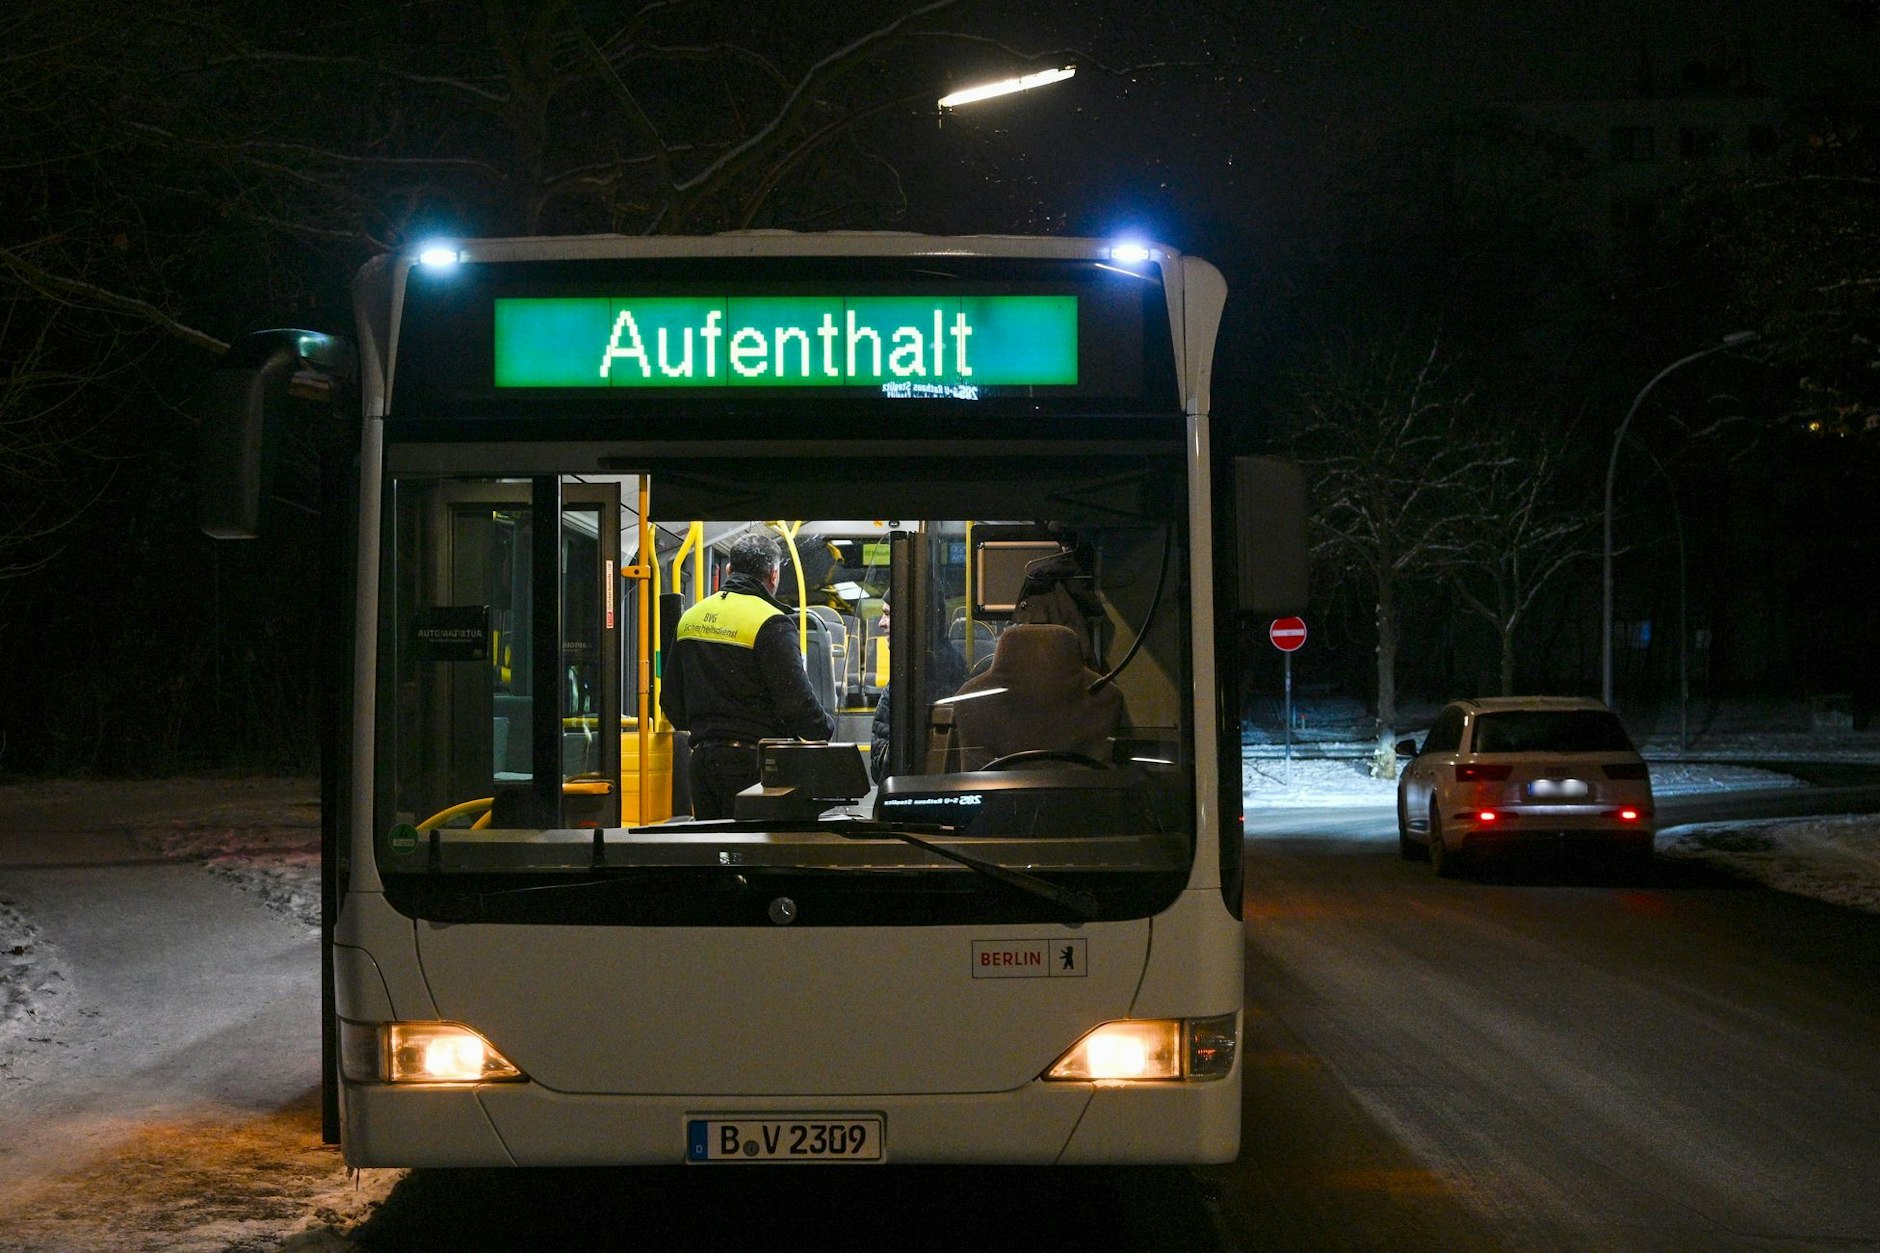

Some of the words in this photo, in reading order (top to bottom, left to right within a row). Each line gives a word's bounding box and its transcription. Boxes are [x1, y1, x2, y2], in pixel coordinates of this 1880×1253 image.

[599, 309, 973, 378] Aufenthalt
[703, 612, 720, 623] BVG
[683, 623, 738, 638] Sicherheitsdienst
[980, 951, 1041, 966] BERLIN
[720, 1125, 740, 1155] B
[762, 1125, 781, 1154] V
[789, 1124, 867, 1154] 2309
[695, 1144, 703, 1154] D
